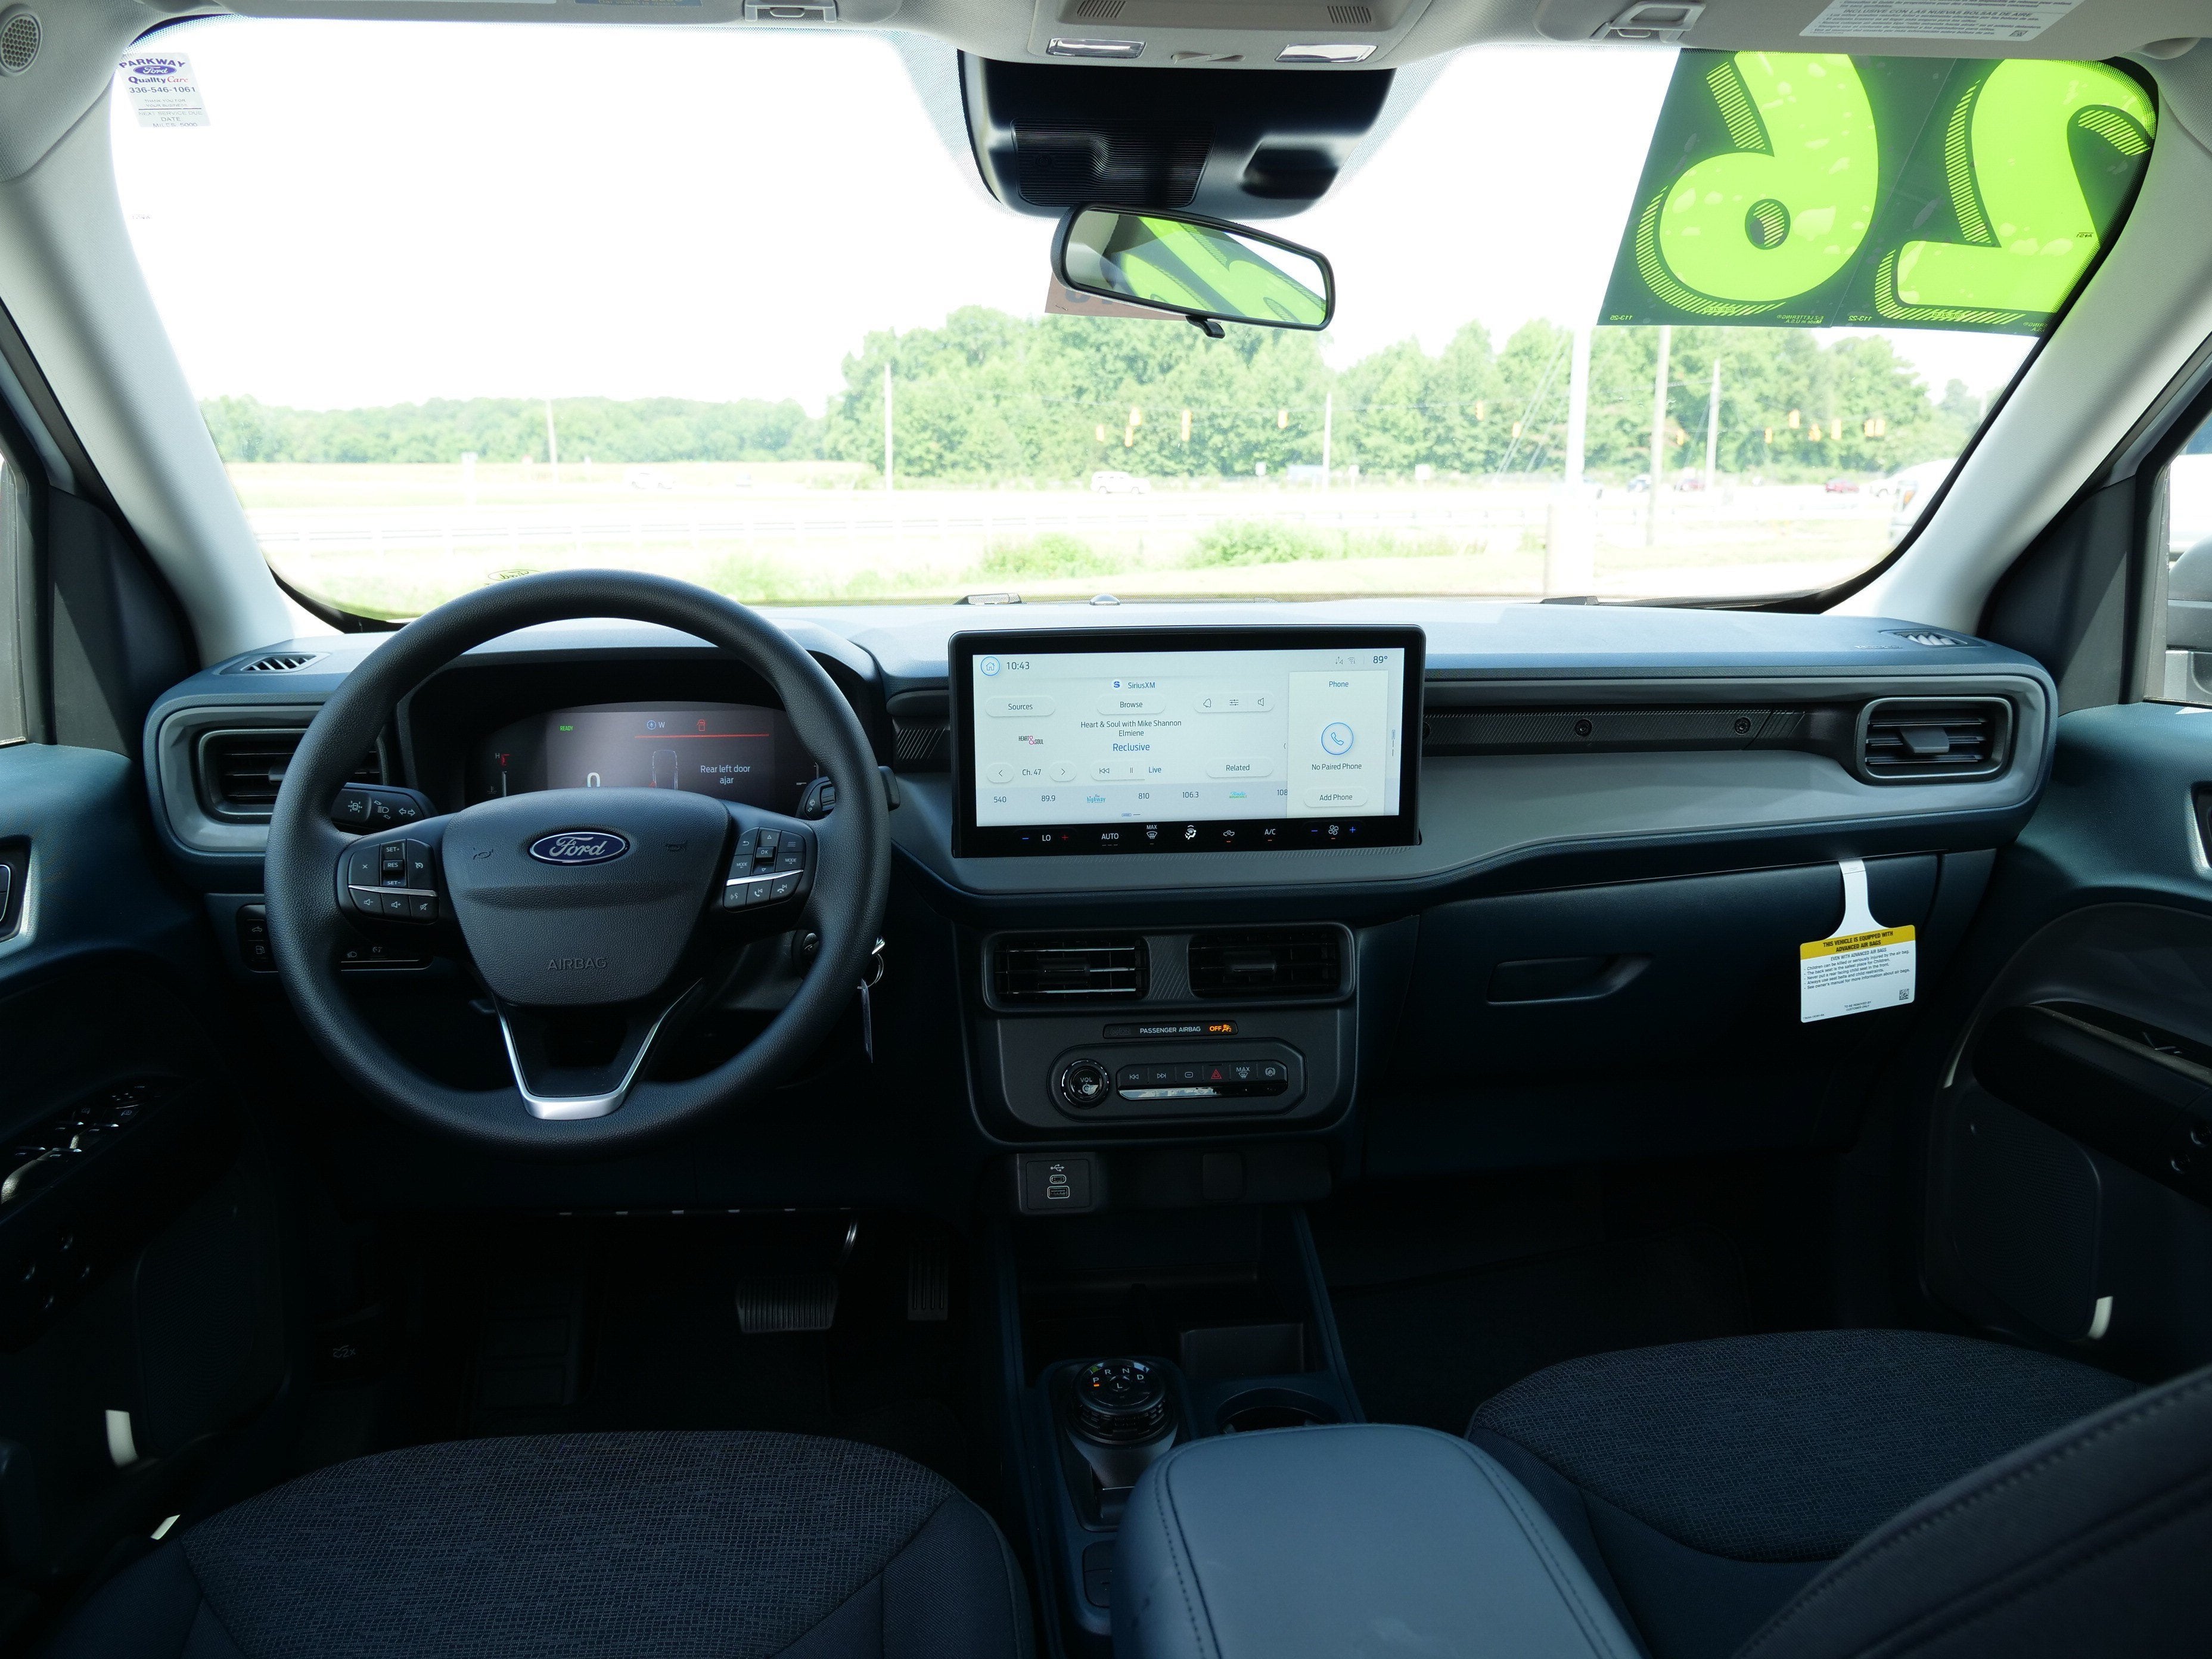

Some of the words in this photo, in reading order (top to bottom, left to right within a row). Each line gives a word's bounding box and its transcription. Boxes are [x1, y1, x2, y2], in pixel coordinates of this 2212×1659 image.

[119, 58, 186, 68] PARKWAY
[143, 66, 169, 74] Ford
[1373, 655, 1388, 664] 89°
[1006, 661, 1030, 670] 10:43
[1113, 743, 1150, 751] Reclusive
[700, 765, 717, 773] Rear
[719, 765, 731, 773] left
[732, 765, 751, 773] door
[720, 776, 734, 785] ajar
[549, 836, 608, 857] Ford
[1836, 944, 1859, 952] ADVANCED
[548, 957, 607, 970] AIRBAG
